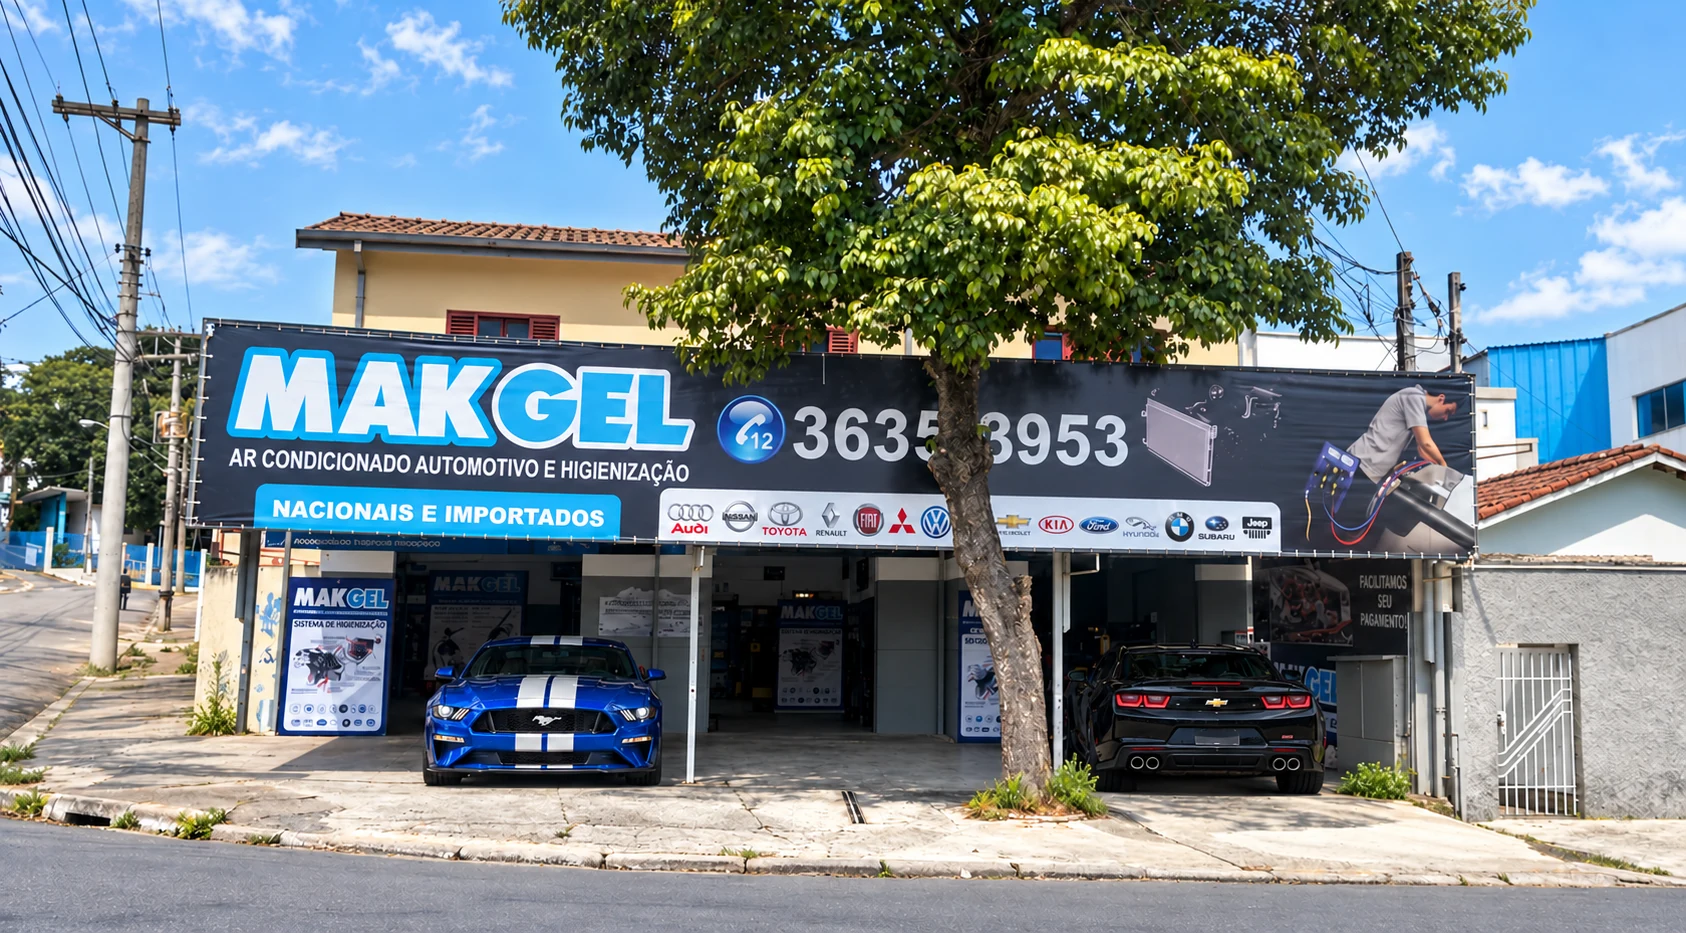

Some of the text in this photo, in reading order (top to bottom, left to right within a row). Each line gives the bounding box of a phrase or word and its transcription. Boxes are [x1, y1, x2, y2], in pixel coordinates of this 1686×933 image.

[228, 348, 695, 451] MAKGEL
[750, 432, 773, 451] 12
[792, 405, 1129, 467] 3635 3953
[229, 448, 690, 487] AR CONDICIONADO AUTOMOTIVO E HIGIENIZAÇÃO
[272, 500, 604, 528] NACIONAIS E IMPORTADOS
[724, 513, 757, 521] NISSAN
[860, 513, 878, 528] FIAT
[671, 523, 708, 534] Audi
[1044, 519, 1069, 530] KIA
[1246, 518, 1269, 529] Jeep
[762, 526, 807, 537] TOYOTA
[815, 529, 848, 537] RENAULT
[1198, 533, 1236, 541] SUBARU
[434, 576, 521, 593] MAKGEL
[1359, 574, 1408, 590] FACILITAMOS
[293, 587, 390, 610] MAKGEL
[1377, 593, 1393, 609] SEU
[780, 605, 844, 620] MAKGEL
[293, 620, 324, 629] SISTEMA
[325, 620, 336, 629] DE
[1360, 612, 1408, 630] PAGAMENTO!
